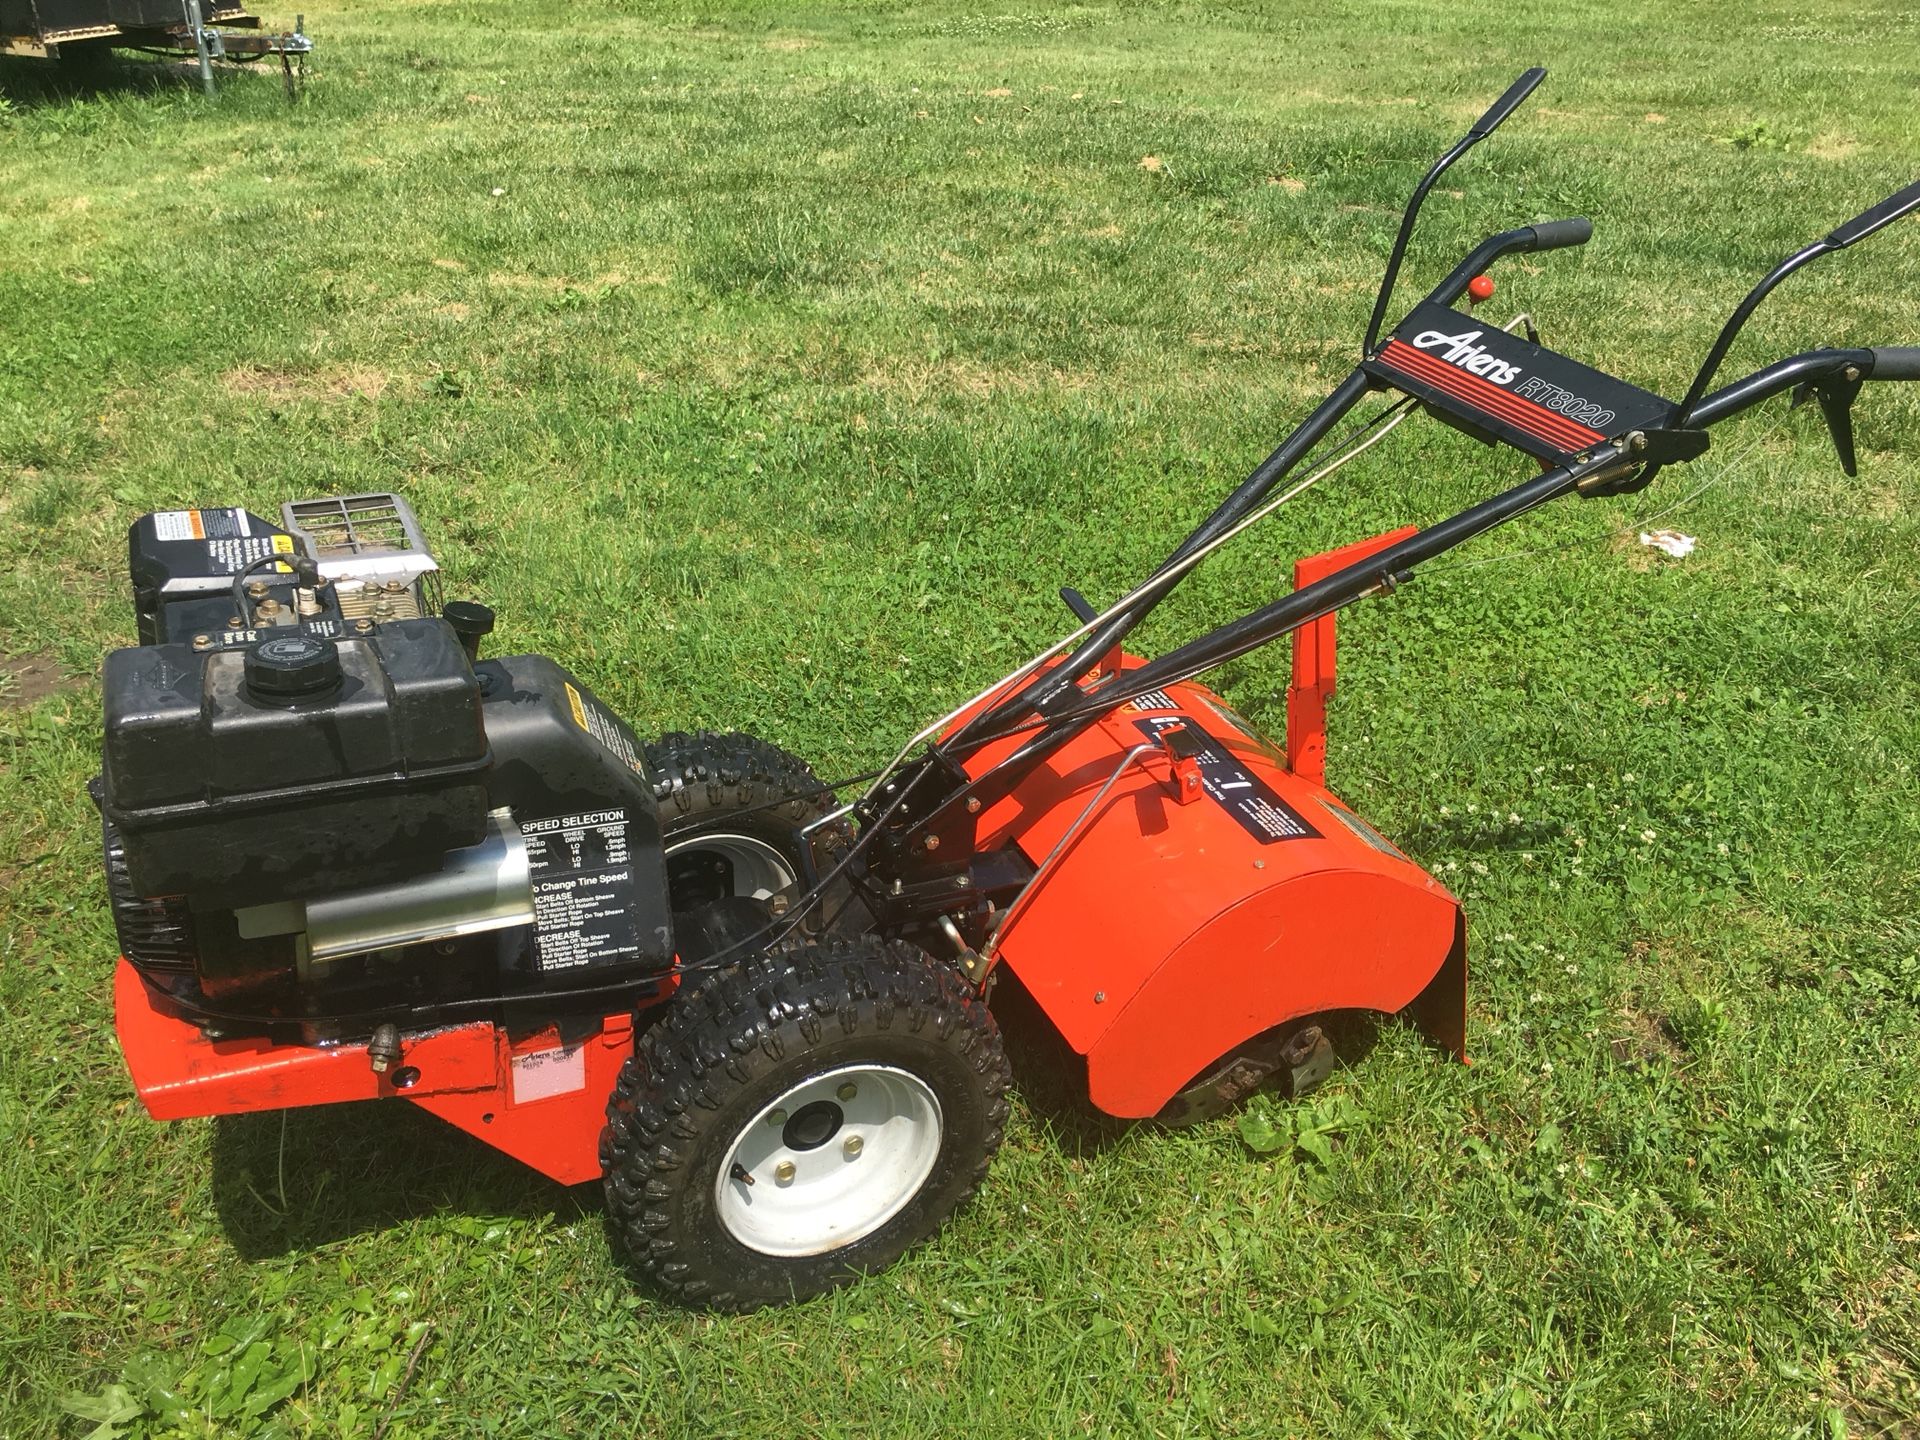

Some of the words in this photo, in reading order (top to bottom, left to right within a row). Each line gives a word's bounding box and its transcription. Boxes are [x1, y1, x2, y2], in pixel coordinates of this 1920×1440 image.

[1412, 330, 1522, 385] Ariens
[1514, 376, 1616, 429] RT8020
[522, 820, 560, 833] SPEED
[562, 810, 624, 827] SELECTION
[597, 825, 624, 833] GROUND
[533, 885, 539, 893] o
[541, 880, 576, 891] Change
[578, 877, 598, 886] Tine
[599, 872, 628, 884] Speed
[534, 892, 573, 904] CREASE
[534, 930, 581, 943] DECREASE
[581, 940, 604, 948] Rotation
[522, 1052, 550, 1062] Ariens
